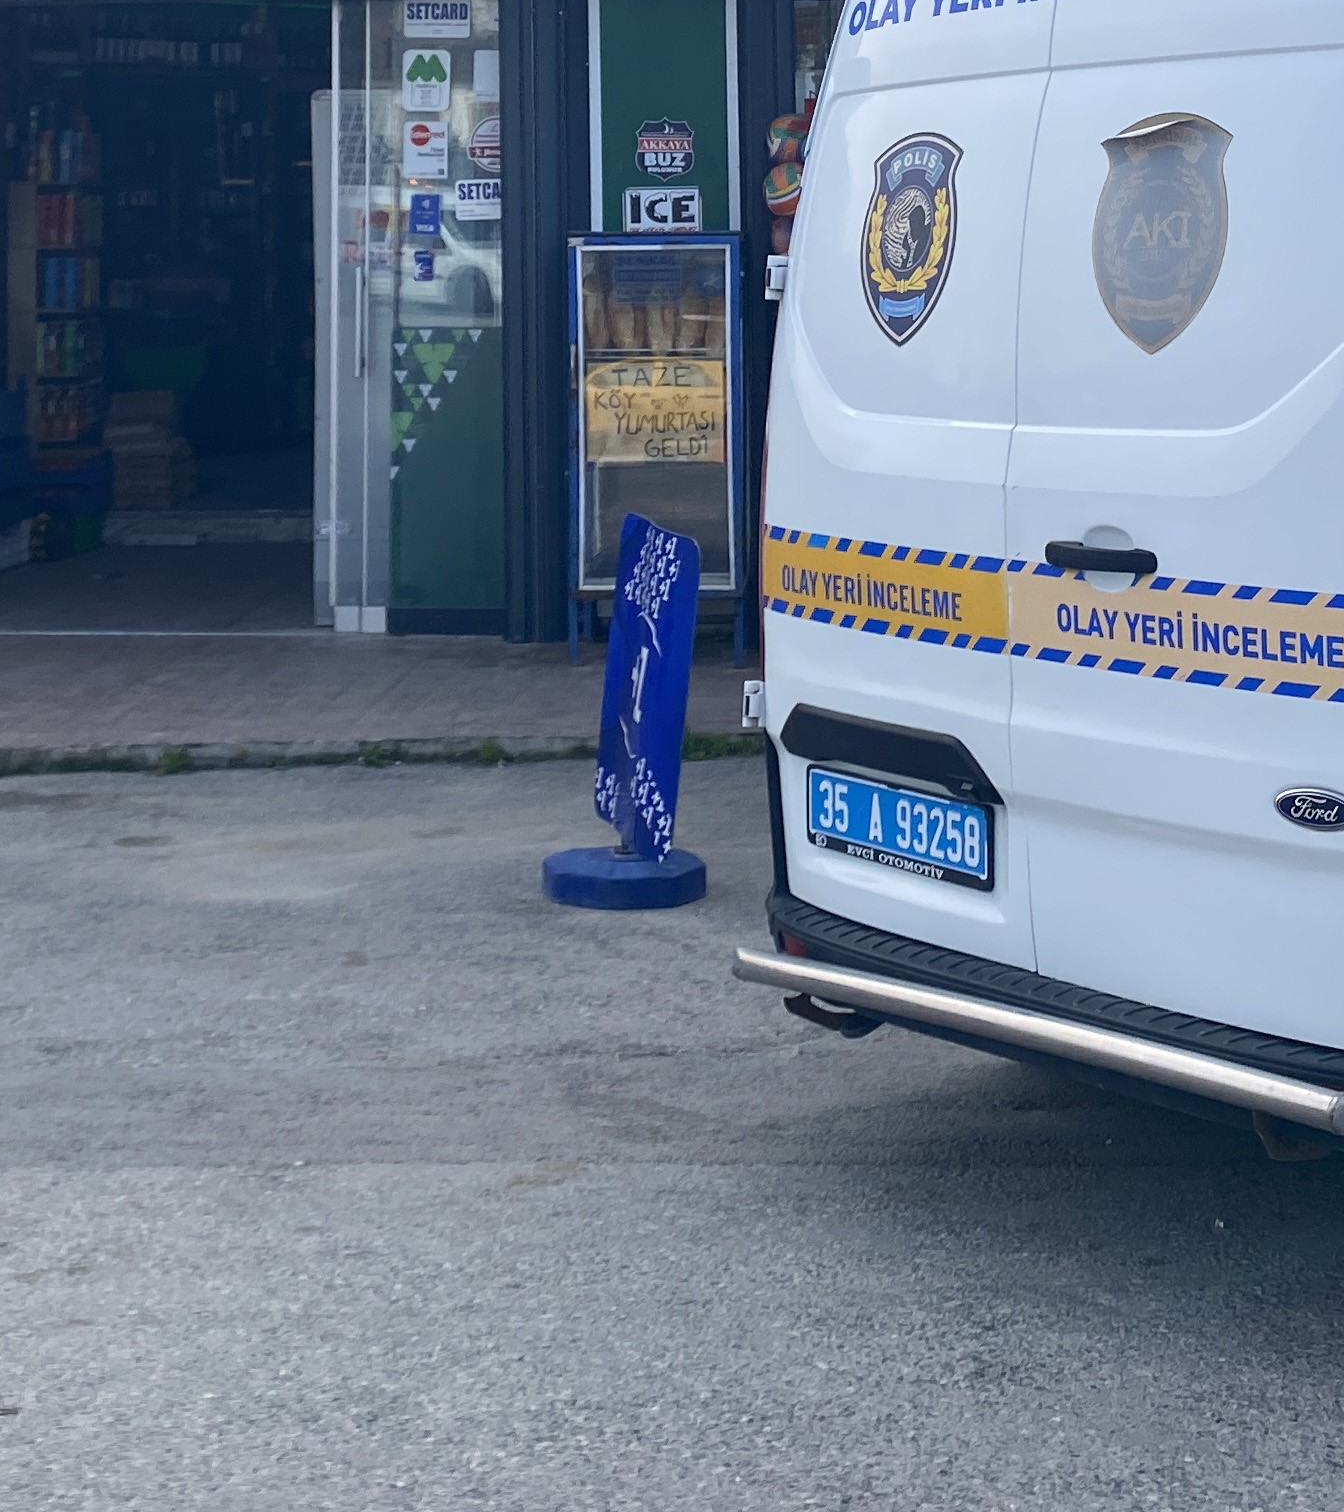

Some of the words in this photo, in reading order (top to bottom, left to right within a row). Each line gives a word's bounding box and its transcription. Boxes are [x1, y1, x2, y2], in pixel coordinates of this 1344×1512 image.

[406, 2, 469, 21] SETCARD
[639, 140, 690, 151] AKKAYA
[643, 152, 686, 167] BUZ
[892, 149, 938, 176] POLİS
[629, 191, 696, 224] ICE
[611, 366, 692, 388] TAZE
[593, 389, 637, 411] KÖY
[614, 410, 716, 436] YUMURTASI
[781, 564, 819, 598] OLAY
[821, 573, 862, 606] YERİ
[865, 573, 963, 622] İNCELEME
[1056, 603, 1120, 640] OLAY
[1125, 611, 1185, 650] YERİ
[1290, 795, 1340, 823] Ford
[818, 779, 849, 833] 35
[868, 792, 884, 844] A
[895, 797, 981, 868] 93258
[846, 843, 875, 861] EVCİ
[878, 852, 945, 880] OTOMOTİV
